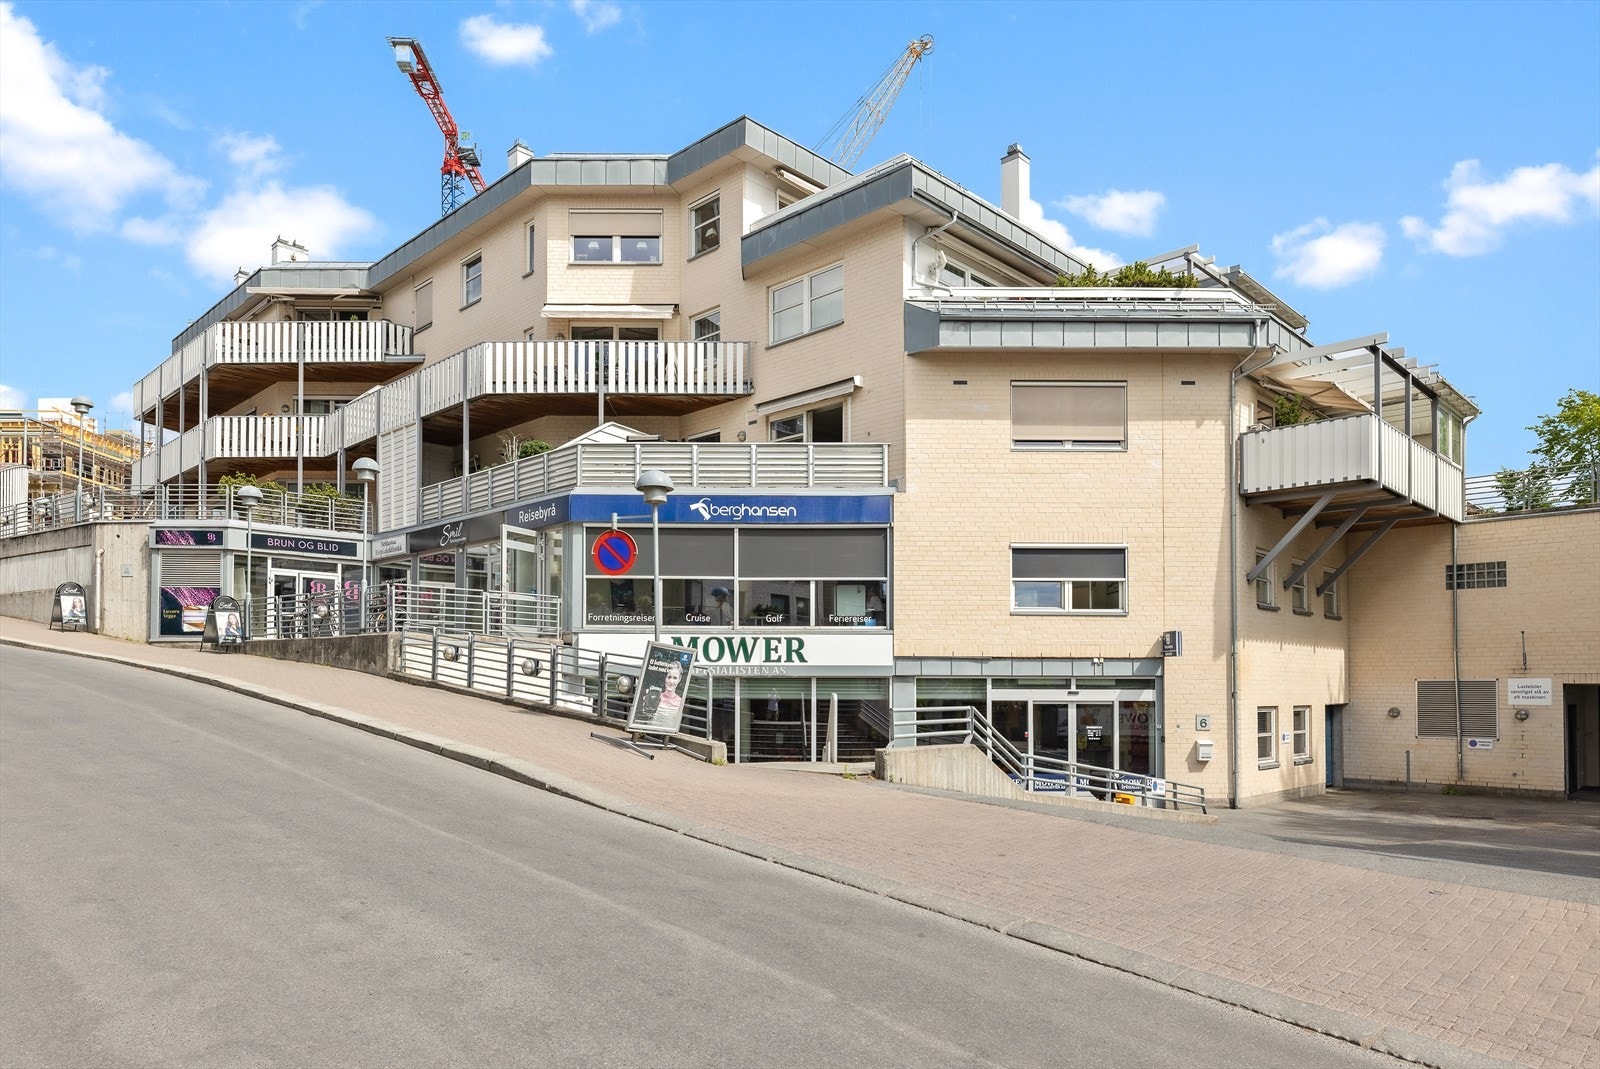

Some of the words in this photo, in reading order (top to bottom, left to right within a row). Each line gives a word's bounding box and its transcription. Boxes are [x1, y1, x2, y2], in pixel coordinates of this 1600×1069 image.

[518, 502, 556, 523] Reisebyrå
[710, 503, 797, 520] berghansen
[440, 522, 463, 546] Smil
[267, 537, 295, 548] BRUN
[298, 540, 314, 550] OG
[317, 542, 339, 551] BLID
[588, 612, 655, 623] Forretningsreiser
[685, 613, 711, 623] Cruise
[765, 614, 783, 623] Golf
[828, 614, 872, 623] Feriereiser
[772, 666, 786, 675] AS
[1200, 718, 1208, 728] 6
